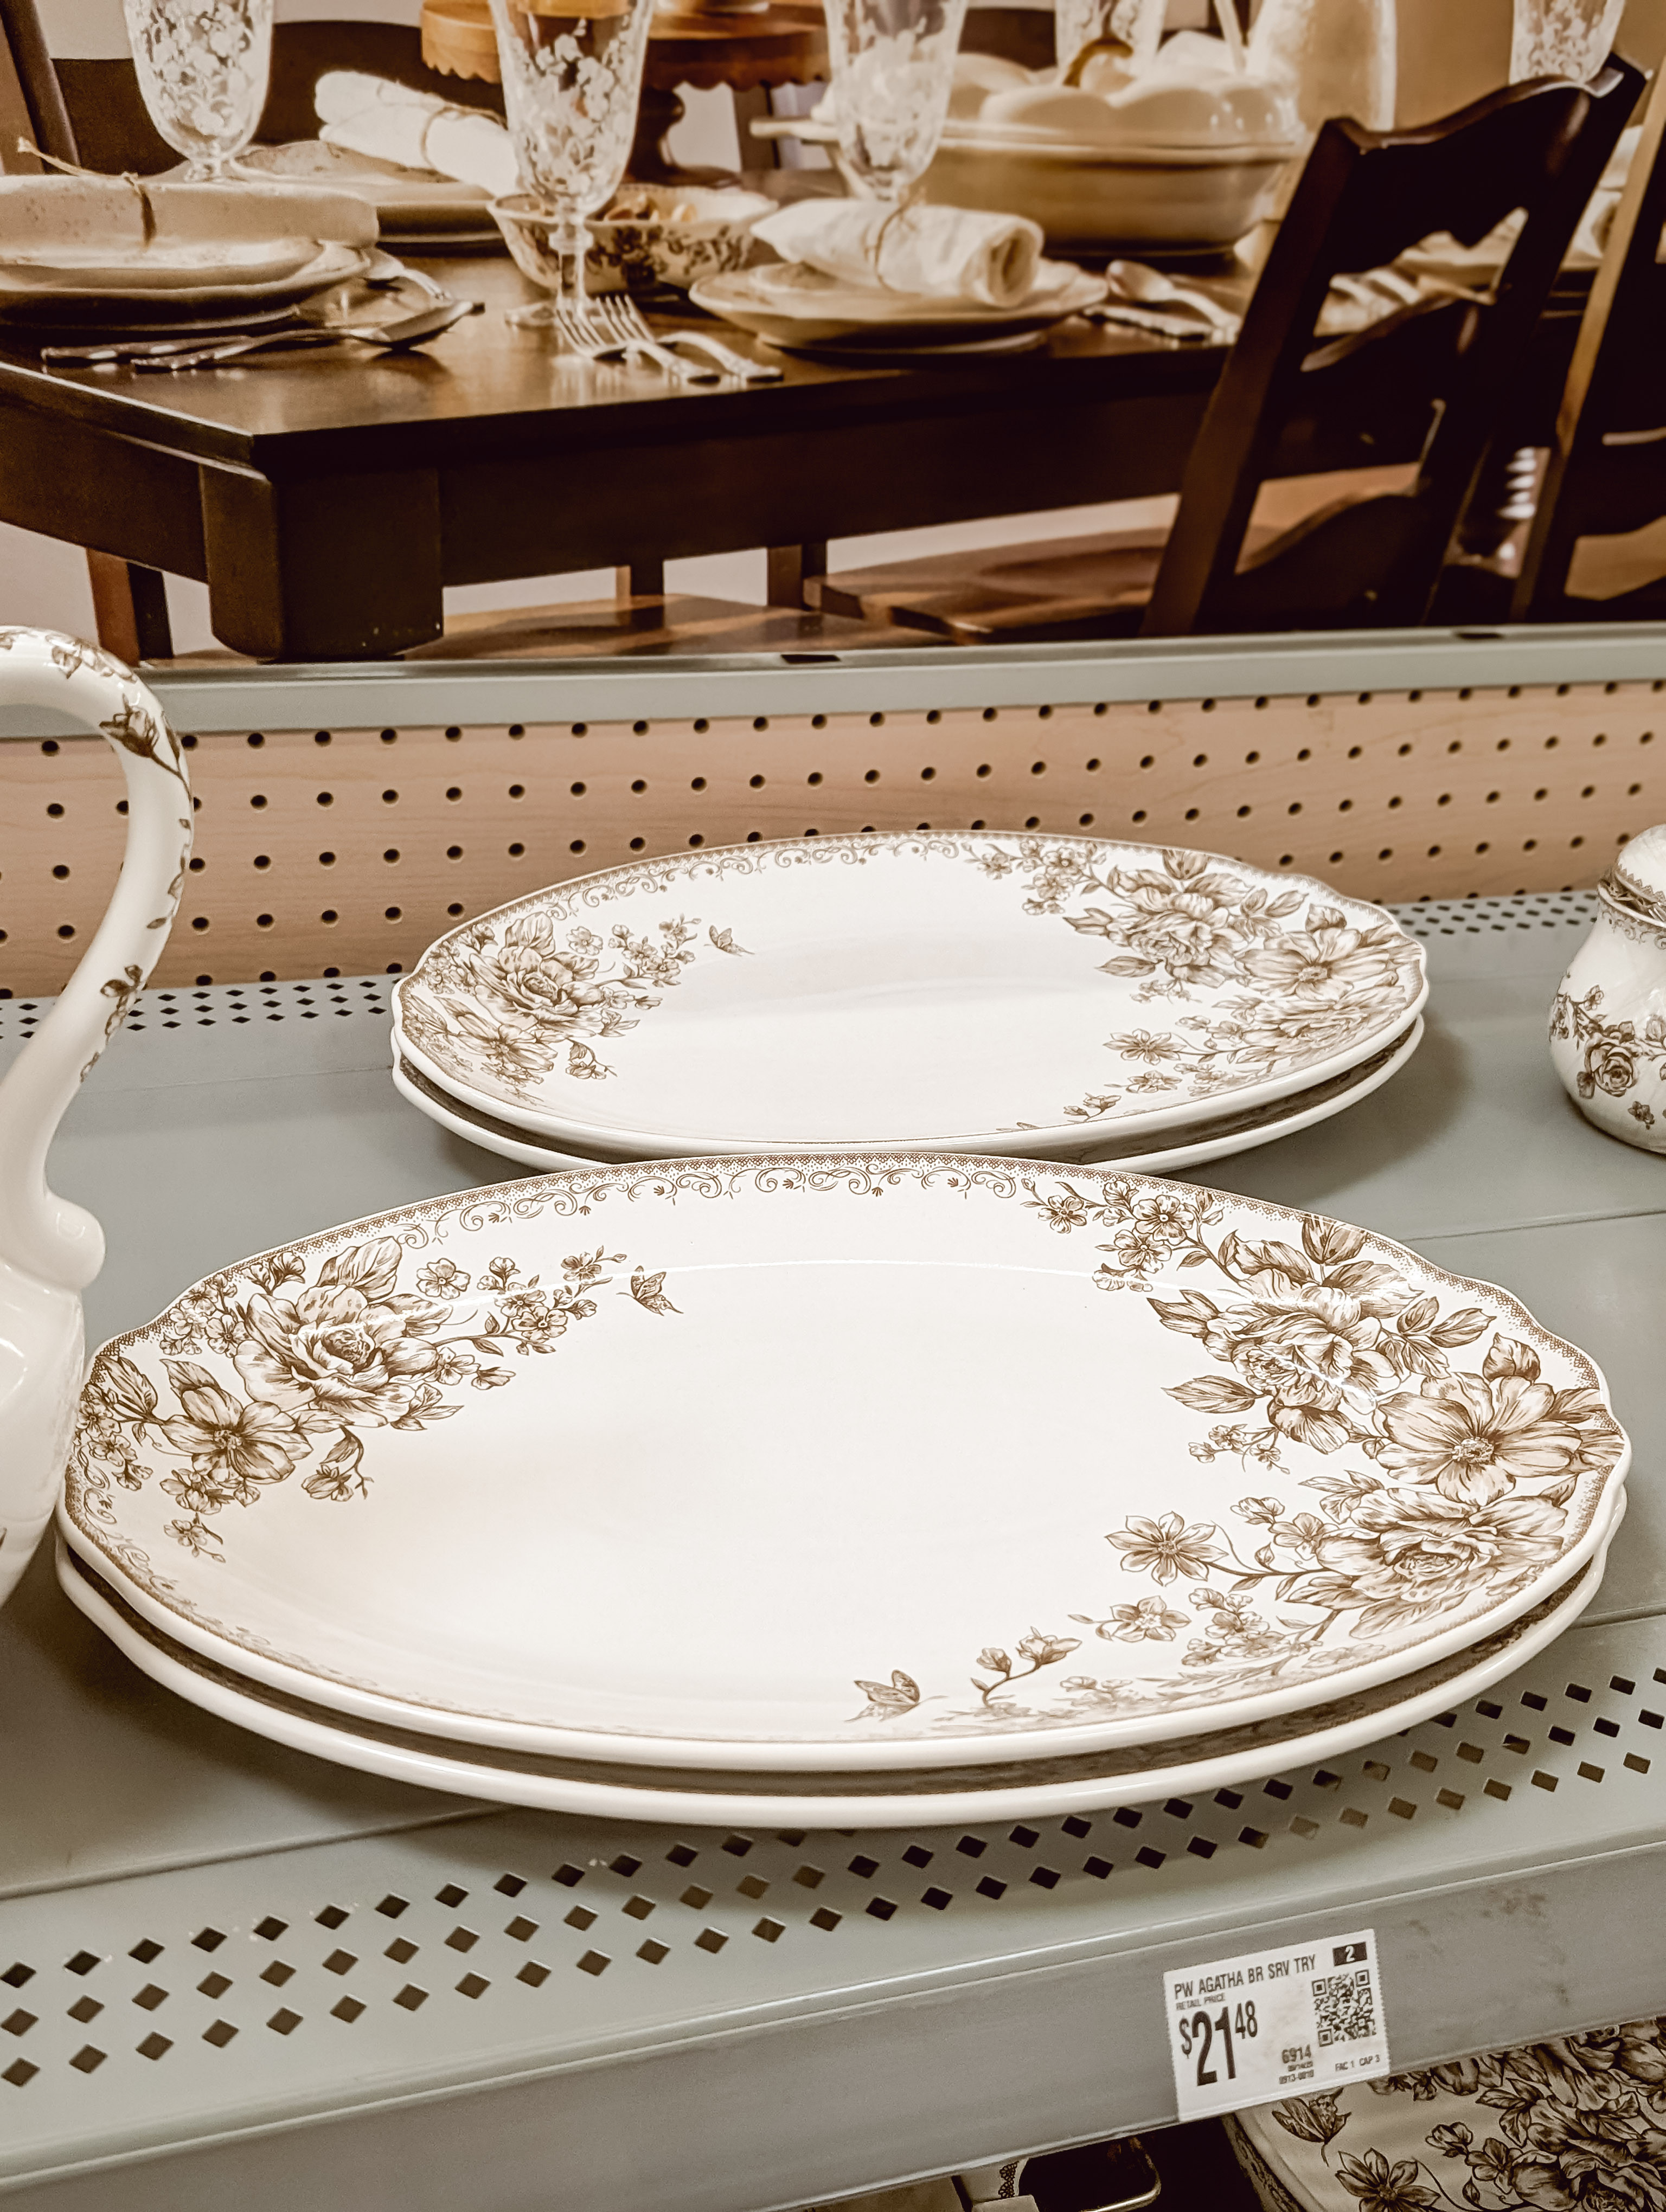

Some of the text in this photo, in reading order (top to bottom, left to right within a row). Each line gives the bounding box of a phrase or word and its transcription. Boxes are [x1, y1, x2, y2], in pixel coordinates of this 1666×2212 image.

[1345, 1945, 1355, 1962] 2
[1175, 1954, 1316, 1999] PW AGATHA BR SRV TRY
[1281, 2044, 1312, 2064] 6914
[1335, 2054, 1381, 2072] FAC 1 CAP 3
